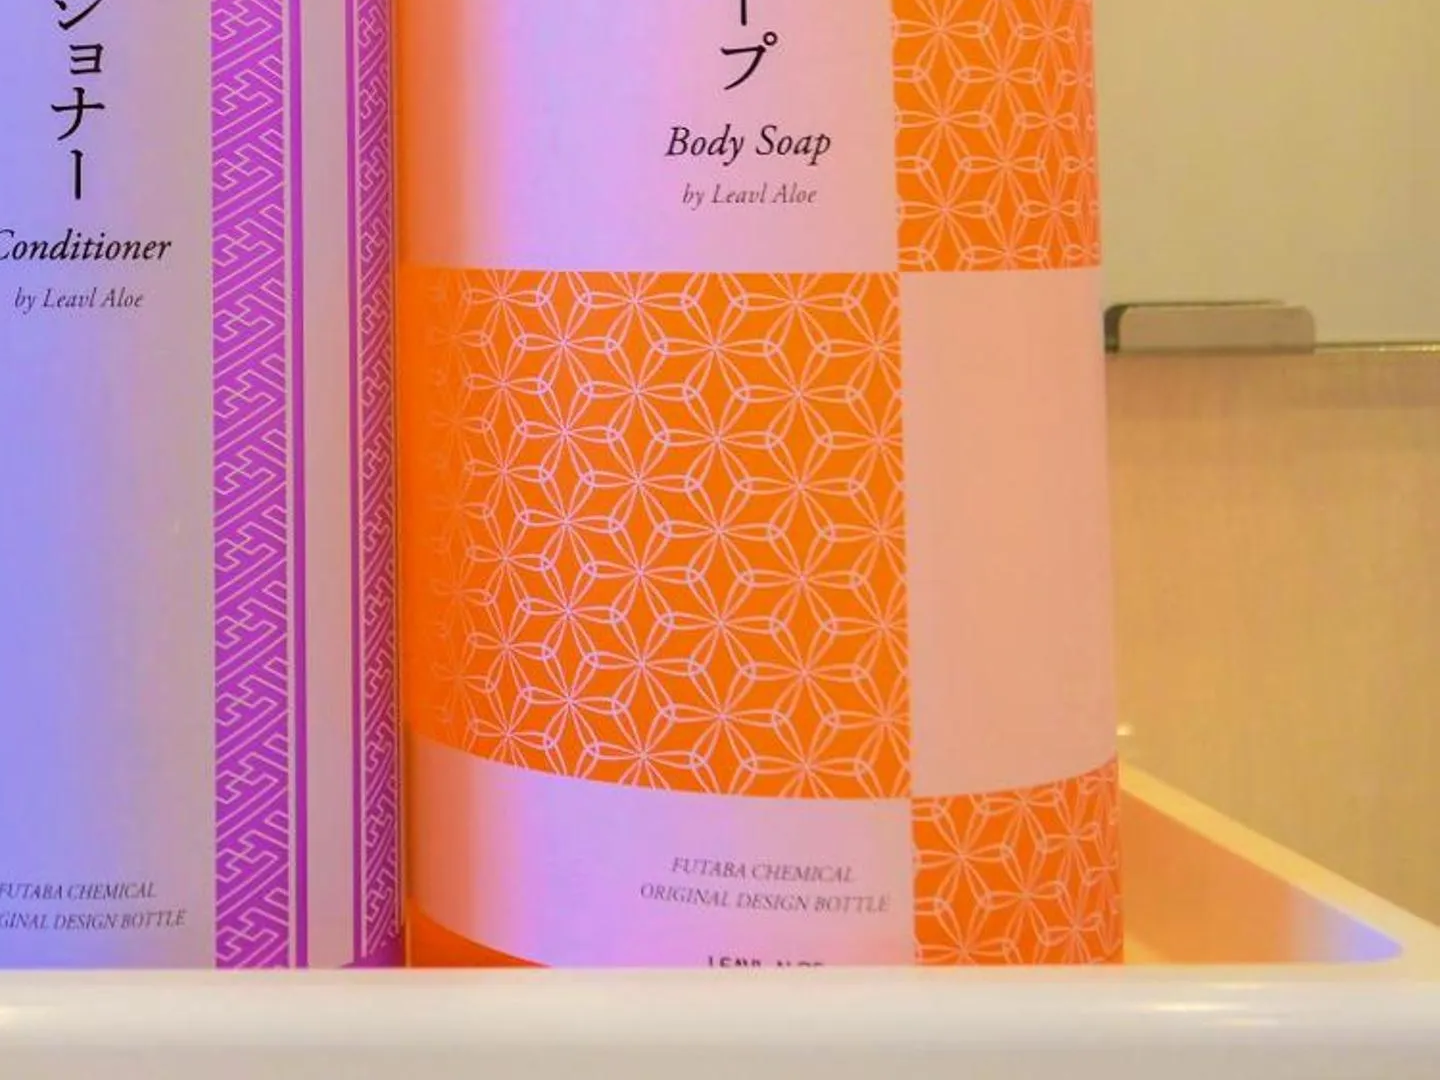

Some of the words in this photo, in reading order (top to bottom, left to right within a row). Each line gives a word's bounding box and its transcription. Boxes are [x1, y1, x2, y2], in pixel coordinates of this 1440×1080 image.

[664, 123, 745, 167] Body
[755, 123, 832, 167] Soap
[682, 182, 706, 212] by
[770, 181, 818, 205] Aloe
[14, 286, 38, 316] by
[100, 286, 144, 309] Aloe
[671, 856, 747, 880] FUTABA
[751, 863, 857, 883] CHEMICAL
[67, 882, 158, 901] CHEMICAL
[639, 882, 732, 908] ORIGINAL
[735, 891, 811, 912] DESIGN
[813, 894, 891, 914] BOTTLE
[52, 912, 121, 931] DESIGN
[121, 908, 188, 930] BOTTLE
